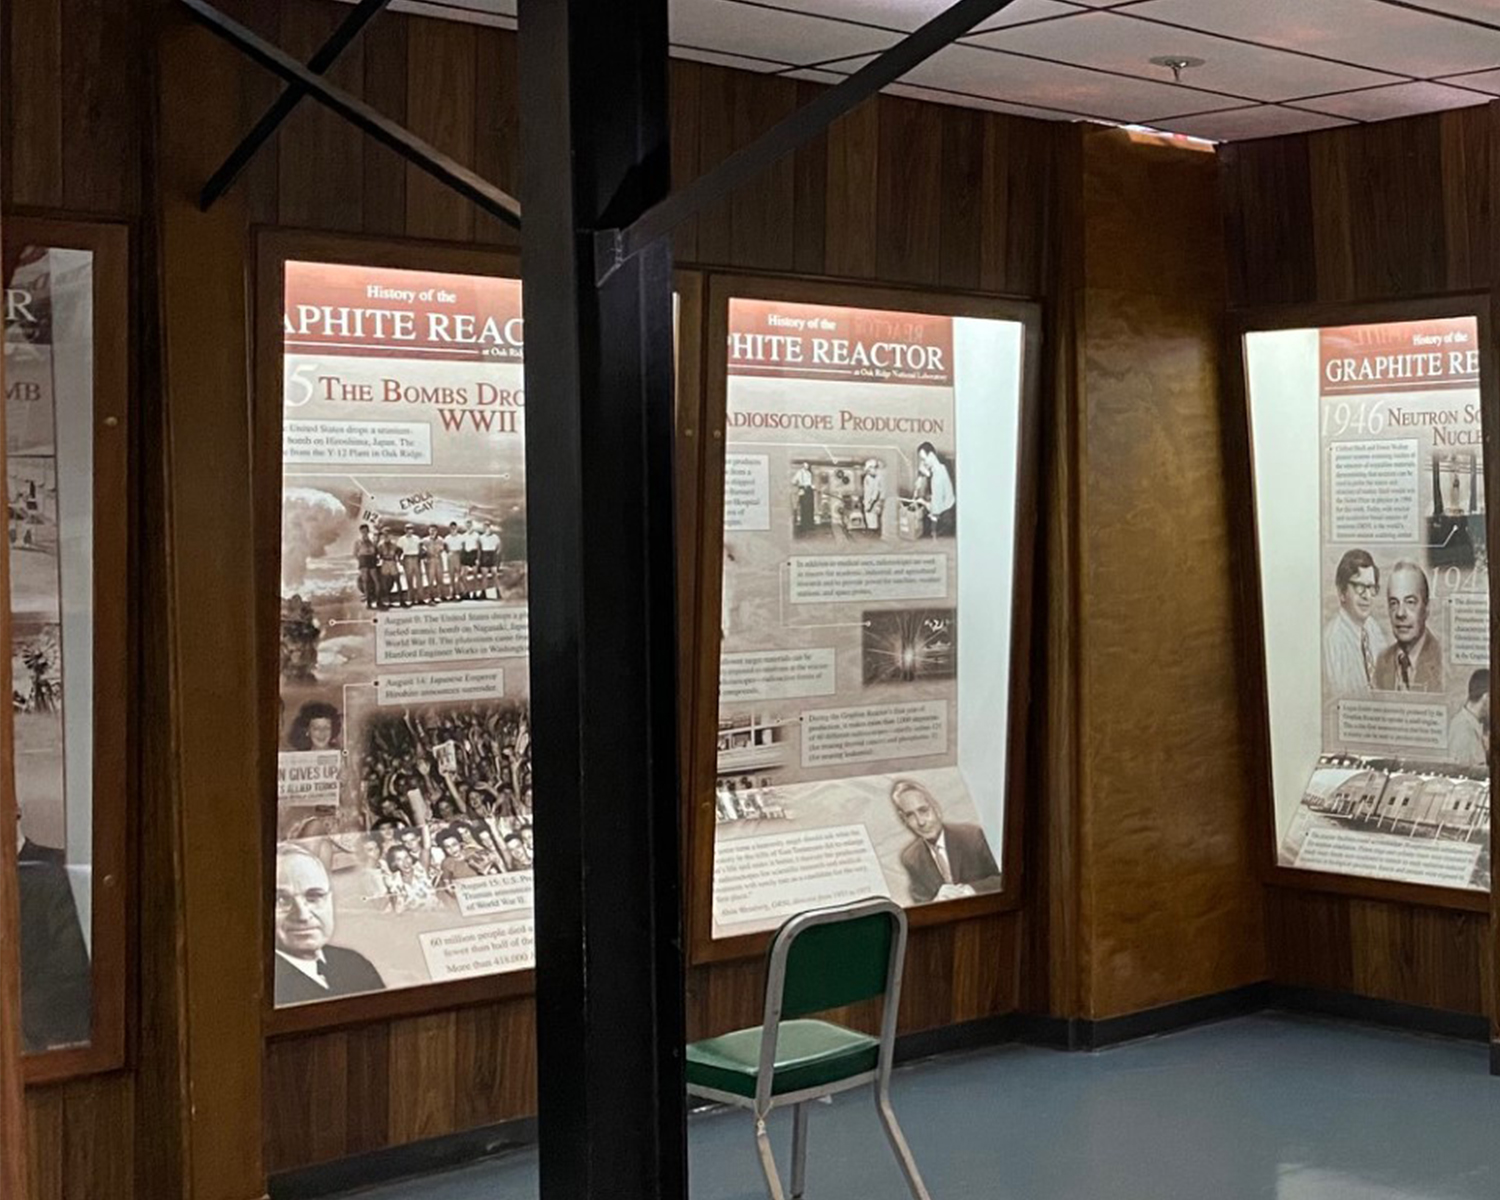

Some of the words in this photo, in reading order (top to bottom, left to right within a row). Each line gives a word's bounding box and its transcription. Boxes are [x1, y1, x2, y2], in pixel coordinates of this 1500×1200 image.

[367, 285, 416, 303] History
[419, 288, 434, 302] of
[437, 290, 456, 303] the
[768, 314, 804, 330] History
[807, 318, 819, 330] of
[821, 318, 836, 331] the
[1413, 333, 1443, 347] History
[1444, 332, 1453, 343] of
[1454, 331, 1469, 342] the
[812, 338, 944, 371] REACTOR
[1325, 353, 1443, 383] GRAPHITE
[319, 376, 373, 402] THE
[381, 379, 467, 406] BOMBS
[438, 408, 517, 433] WWII
[840, 410, 944, 433] PRODUCTION
[1322, 400, 1385, 437] 1946
[1388, 407, 1459, 427] NEUTRON
[414, 501, 434, 514] GAY
[289, 768, 321, 781] GIVES
